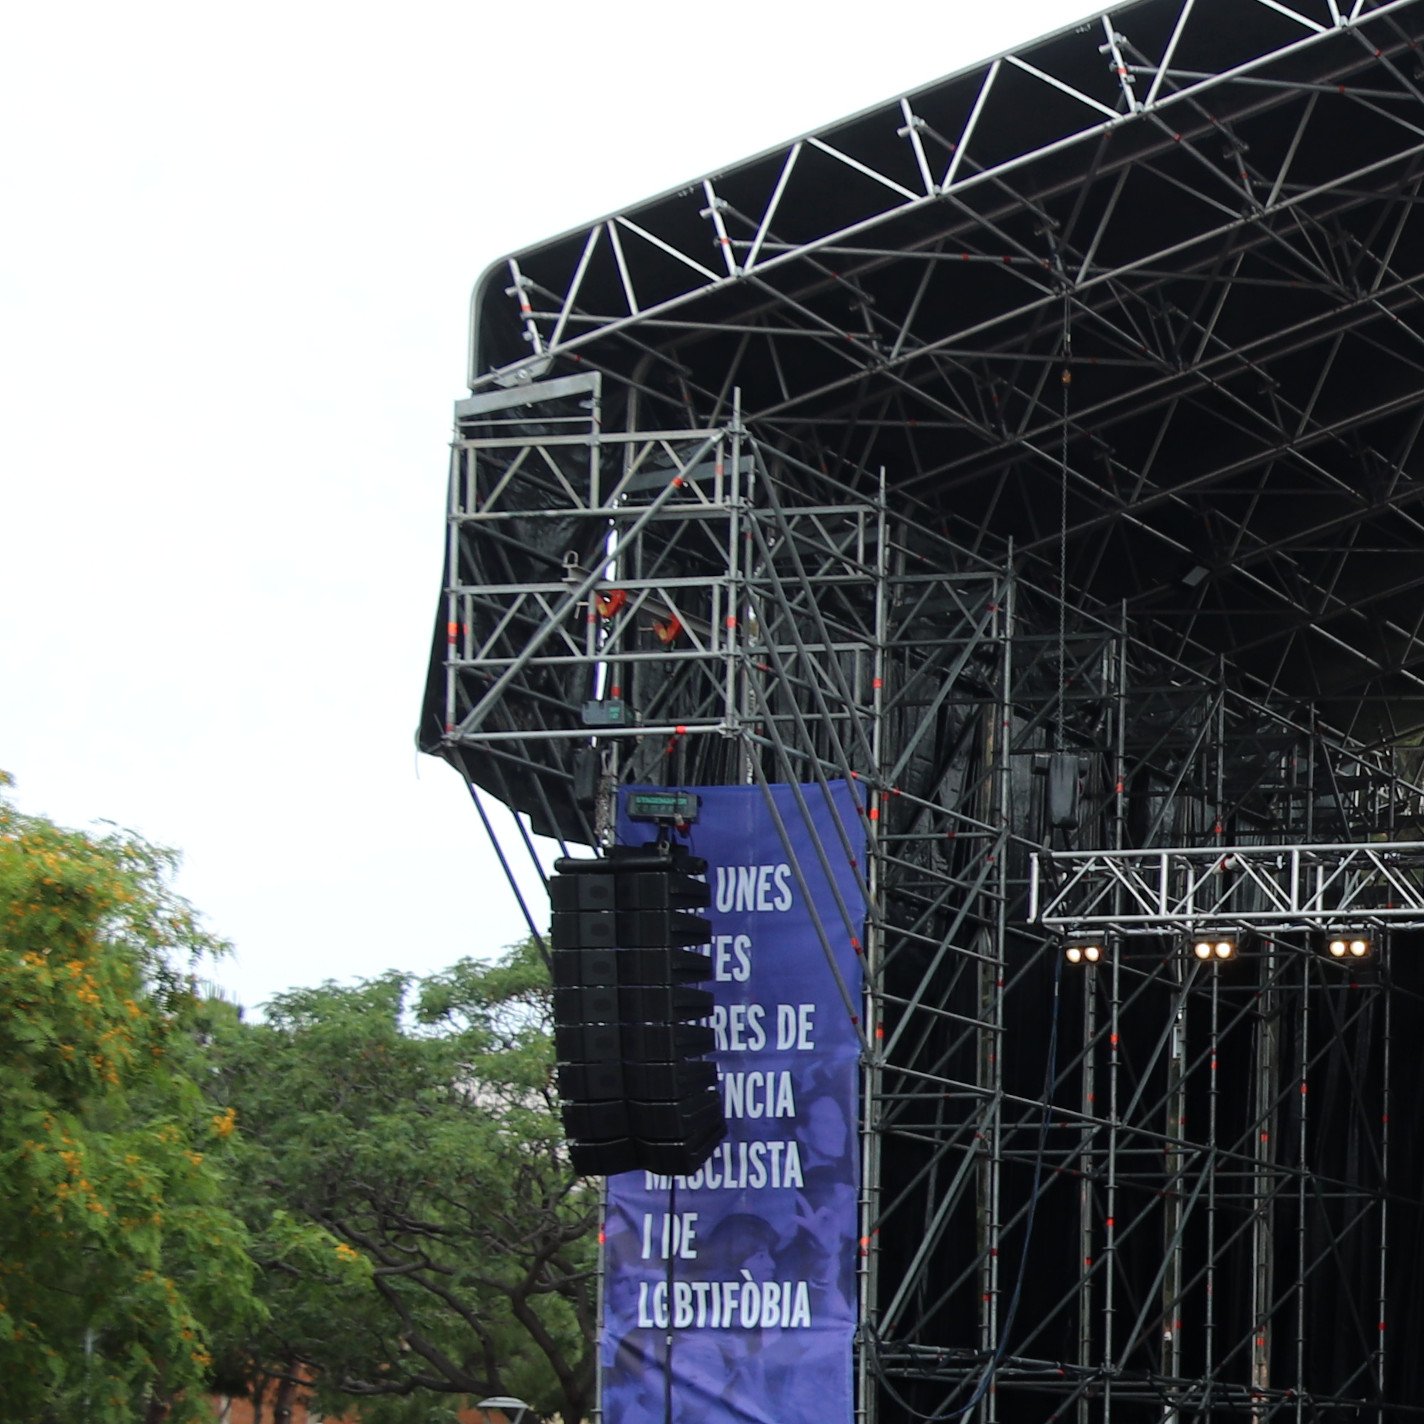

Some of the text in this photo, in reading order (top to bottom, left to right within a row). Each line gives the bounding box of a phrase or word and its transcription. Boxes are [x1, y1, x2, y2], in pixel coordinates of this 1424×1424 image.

[716, 864, 793, 913] UNES
[776, 1003, 816, 1051] DE
[645, 1141, 804, 1190] CLISTA
[638, 1269, 811, 1328] LGBTIFÒBIA
